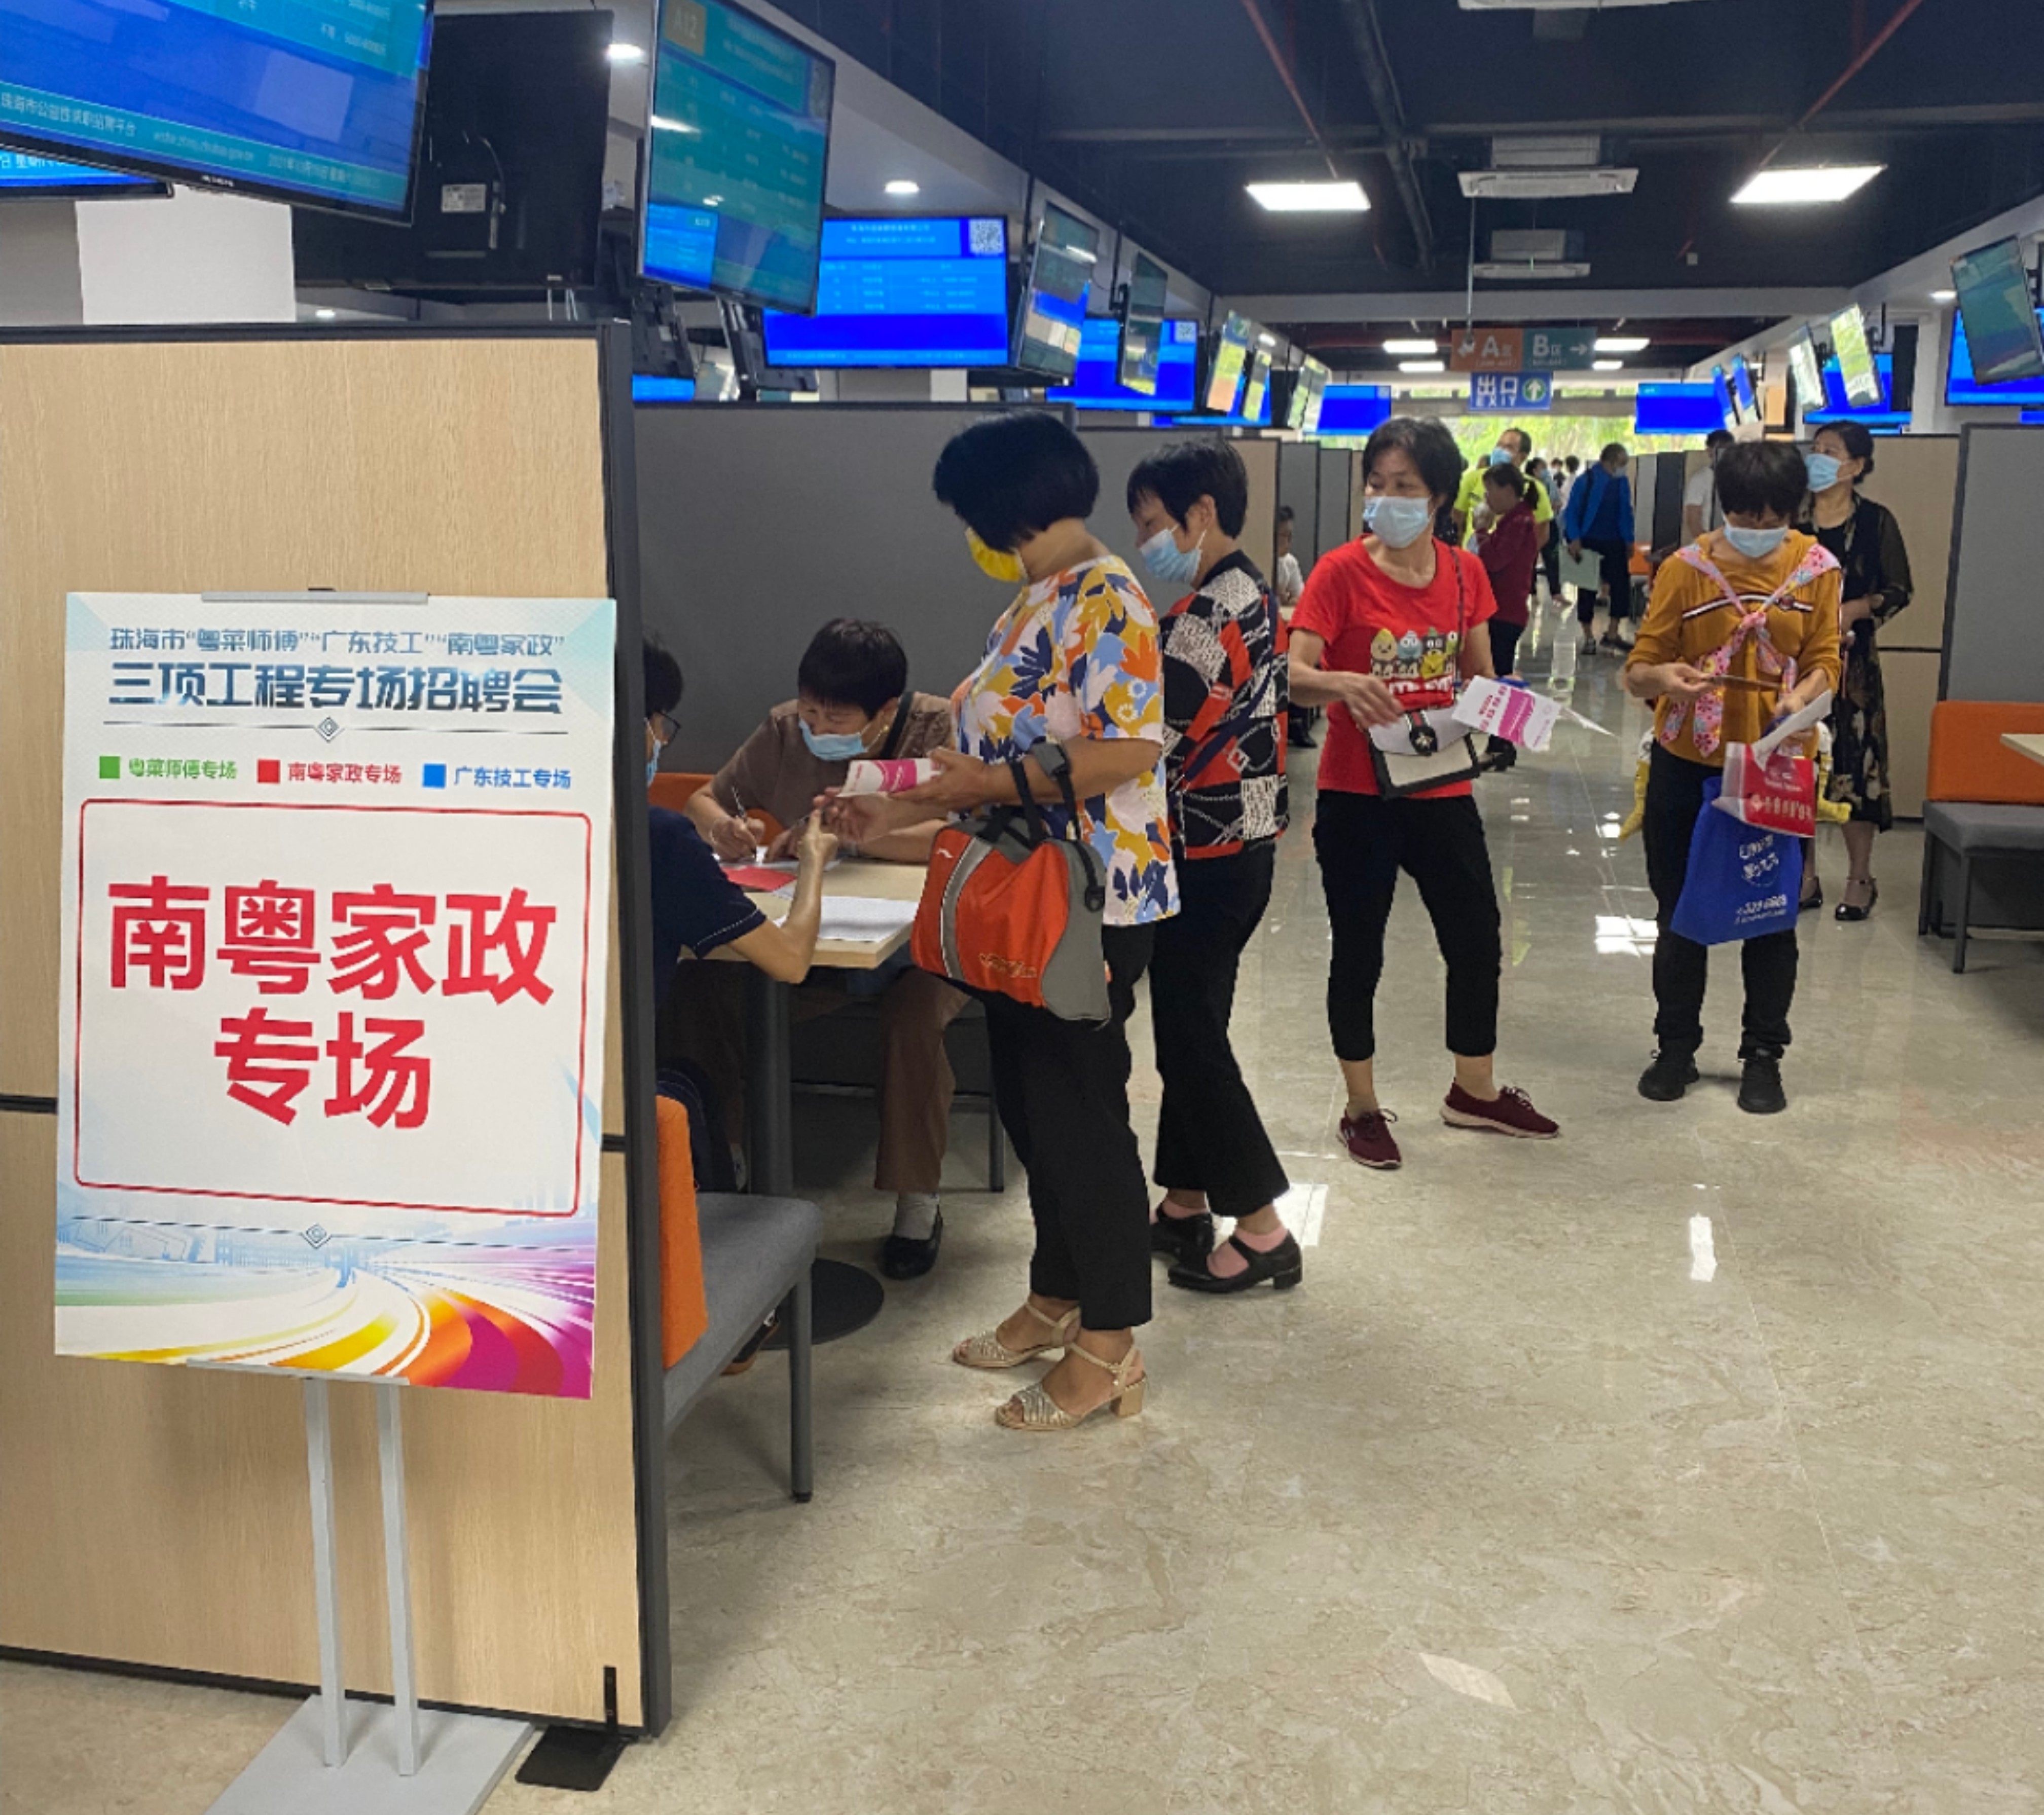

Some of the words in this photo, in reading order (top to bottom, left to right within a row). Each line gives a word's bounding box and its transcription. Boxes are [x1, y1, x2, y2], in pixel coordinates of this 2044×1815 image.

[1476, 395, 1516, 408] EXIT
[1477, 374, 1519, 395] 出口
[108, 661, 563, 714] 三项工程专场招聘会
[288, 762, 402, 784] 南粤家政专场
[454, 765, 571, 789] 广东技工专场
[108, 875, 557, 1006] 南粤家政
[213, 1006, 432, 1129] 专场
